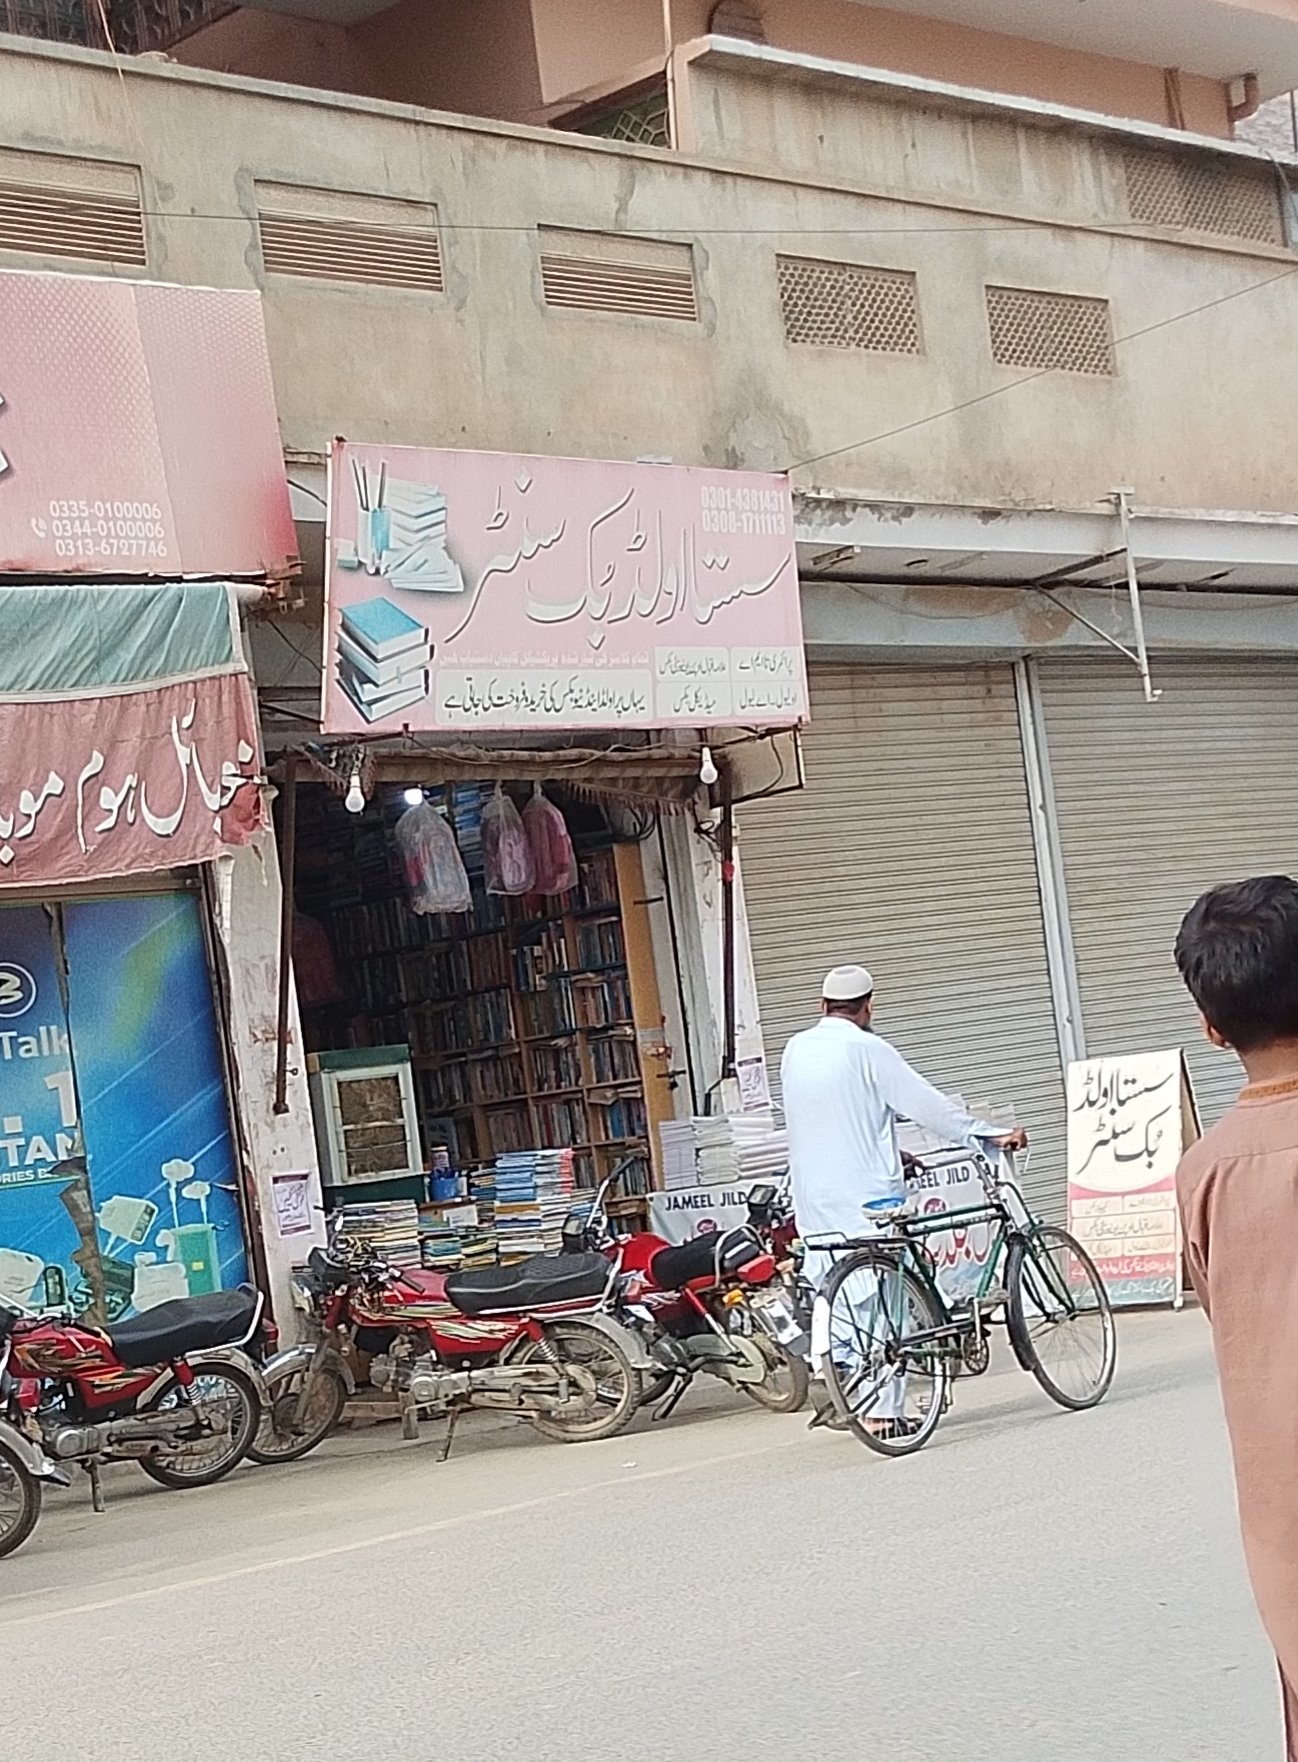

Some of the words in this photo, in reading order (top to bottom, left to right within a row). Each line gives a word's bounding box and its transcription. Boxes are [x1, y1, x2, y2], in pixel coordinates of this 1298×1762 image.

[49, 500, 162, 520] 0335-0100006
[52, 519, 165, 538] 0344-0100006
[55, 538, 167, 558] 0313-6727746
[444, 466, 566, 644] سنٹر
[606, 507, 687, 625] اولڈ
[689, 522, 792, 626] سستا
[620, 688, 646, 715] یہاں
[1072, 1066, 1115, 1113] اولڈ
[1116, 1066, 1174, 1107] سستا
[946, 1166, 970, 1186] JILD
[664, 1193, 714, 1211] JAMEEL
[719, 1191, 747, 1208] JILD
